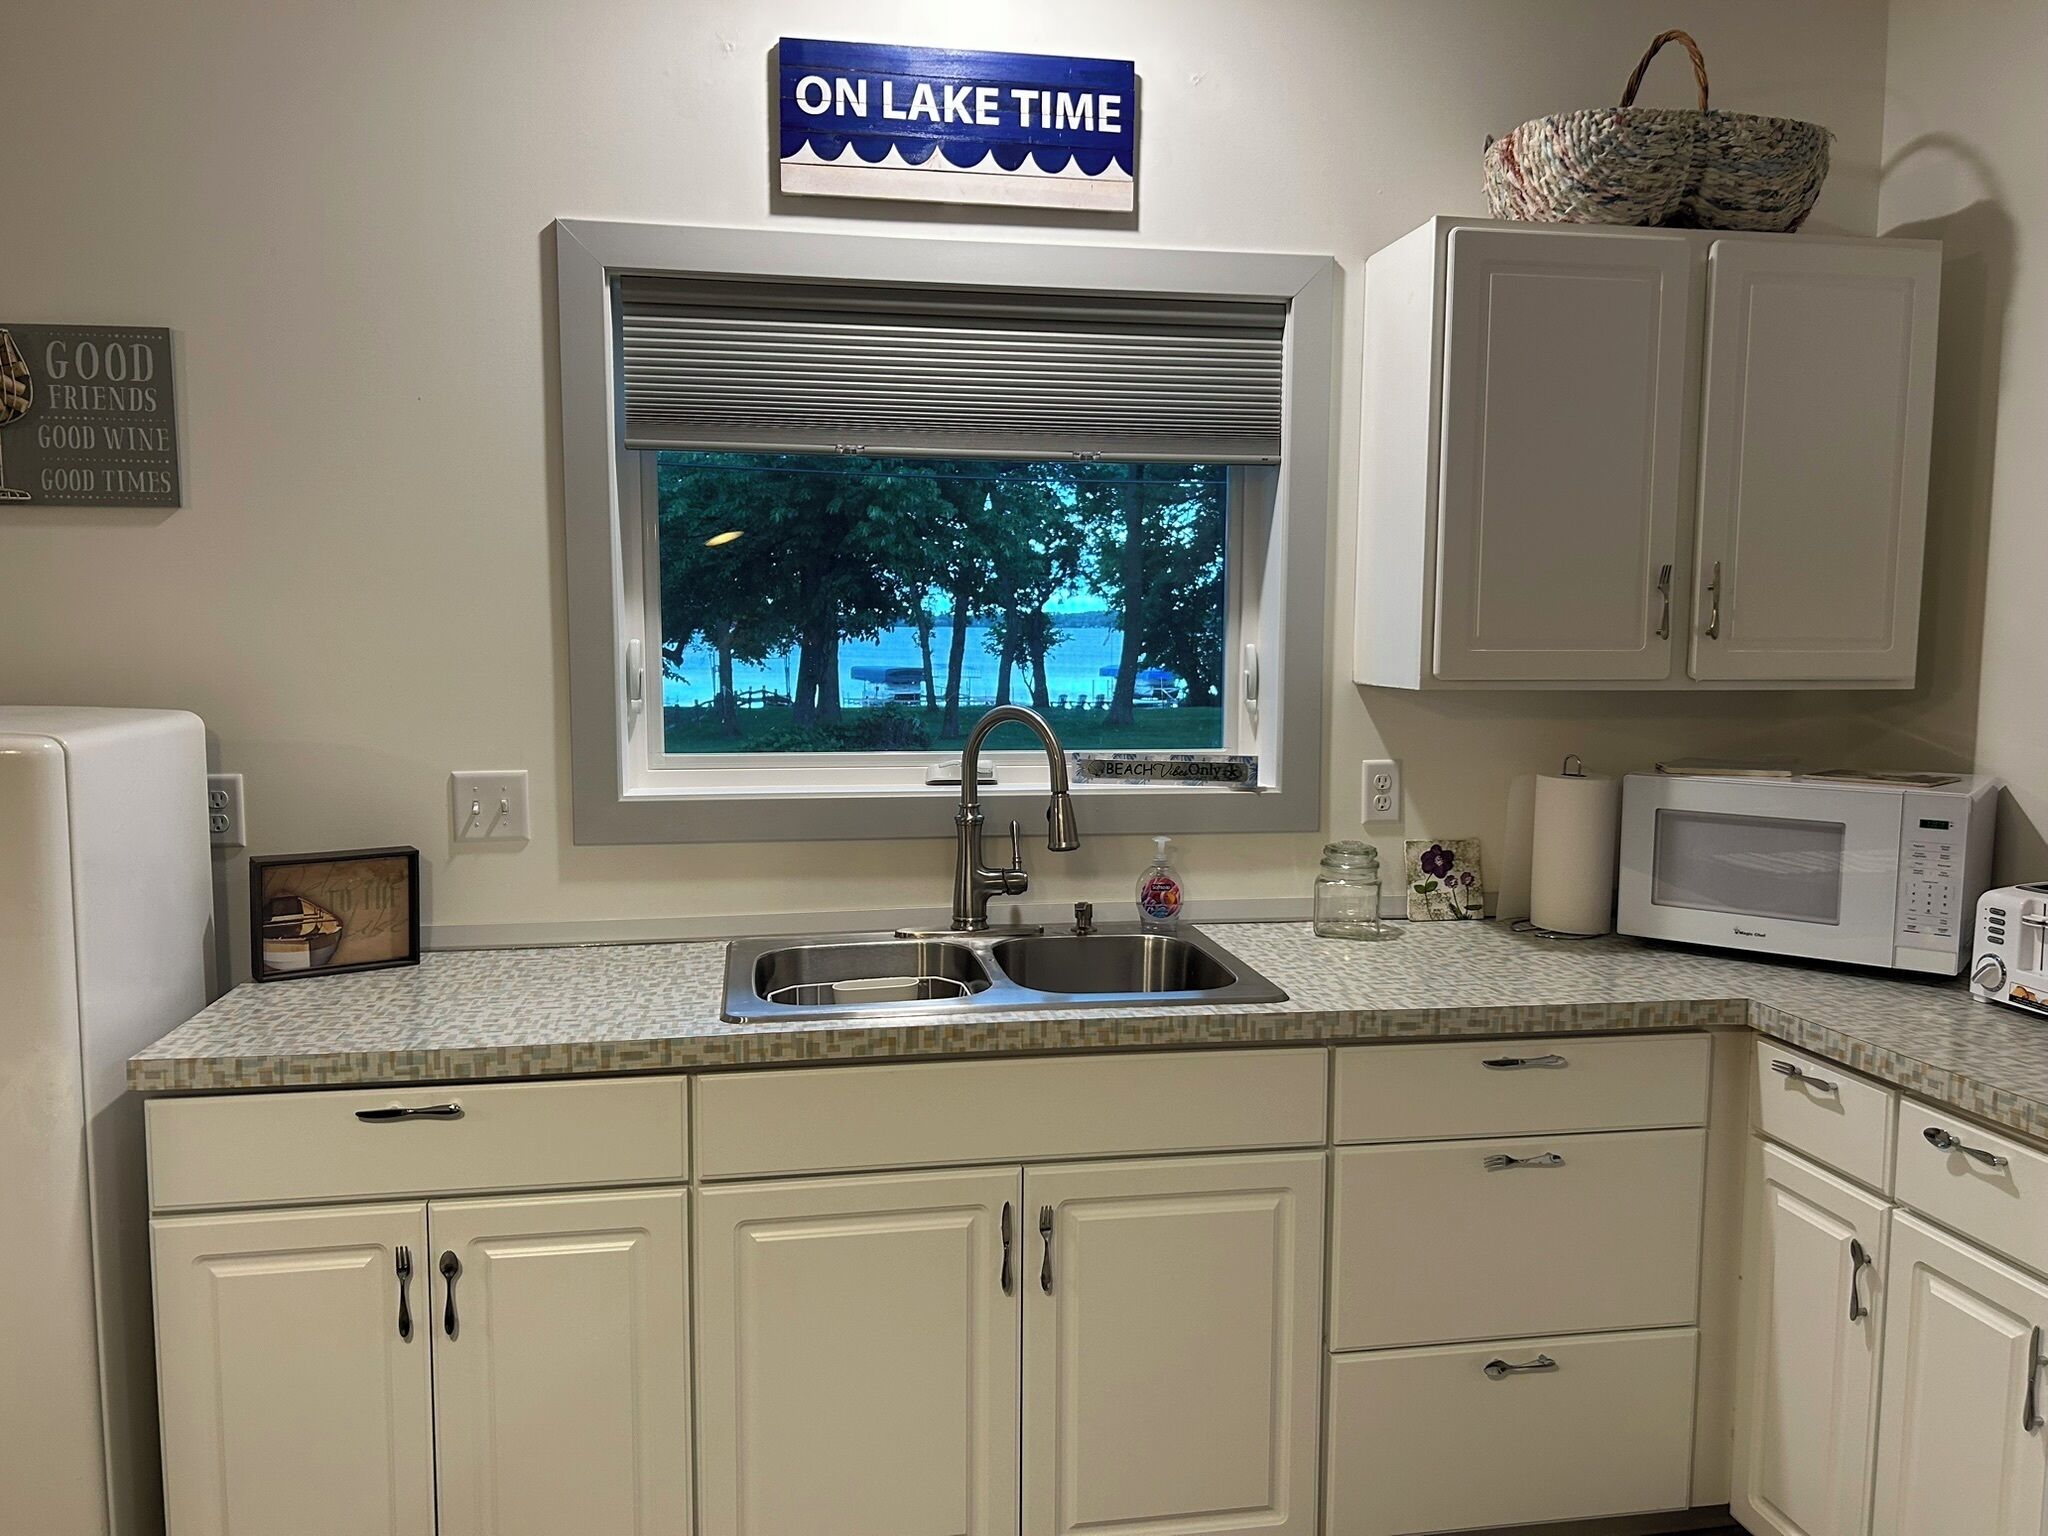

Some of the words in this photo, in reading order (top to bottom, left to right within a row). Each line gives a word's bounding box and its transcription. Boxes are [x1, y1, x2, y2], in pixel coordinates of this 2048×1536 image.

[795, 75, 868, 118] ON
[882, 80, 1000, 126] LAKE
[1010, 88, 1122, 134] TIME
[45, 340, 154, 382] GOOD
[48, 384, 157, 412] FRIENDS
[38, 424, 96, 449] GOOD
[102, 426, 170, 452] WINE
[41, 468, 96, 492] GOOD
[102, 470, 171, 494] TIMES
[1106, 763, 1153, 776] BEACH
[1153, 763, 1188, 778] Vibes
[1188, 763, 1223, 779] Only
